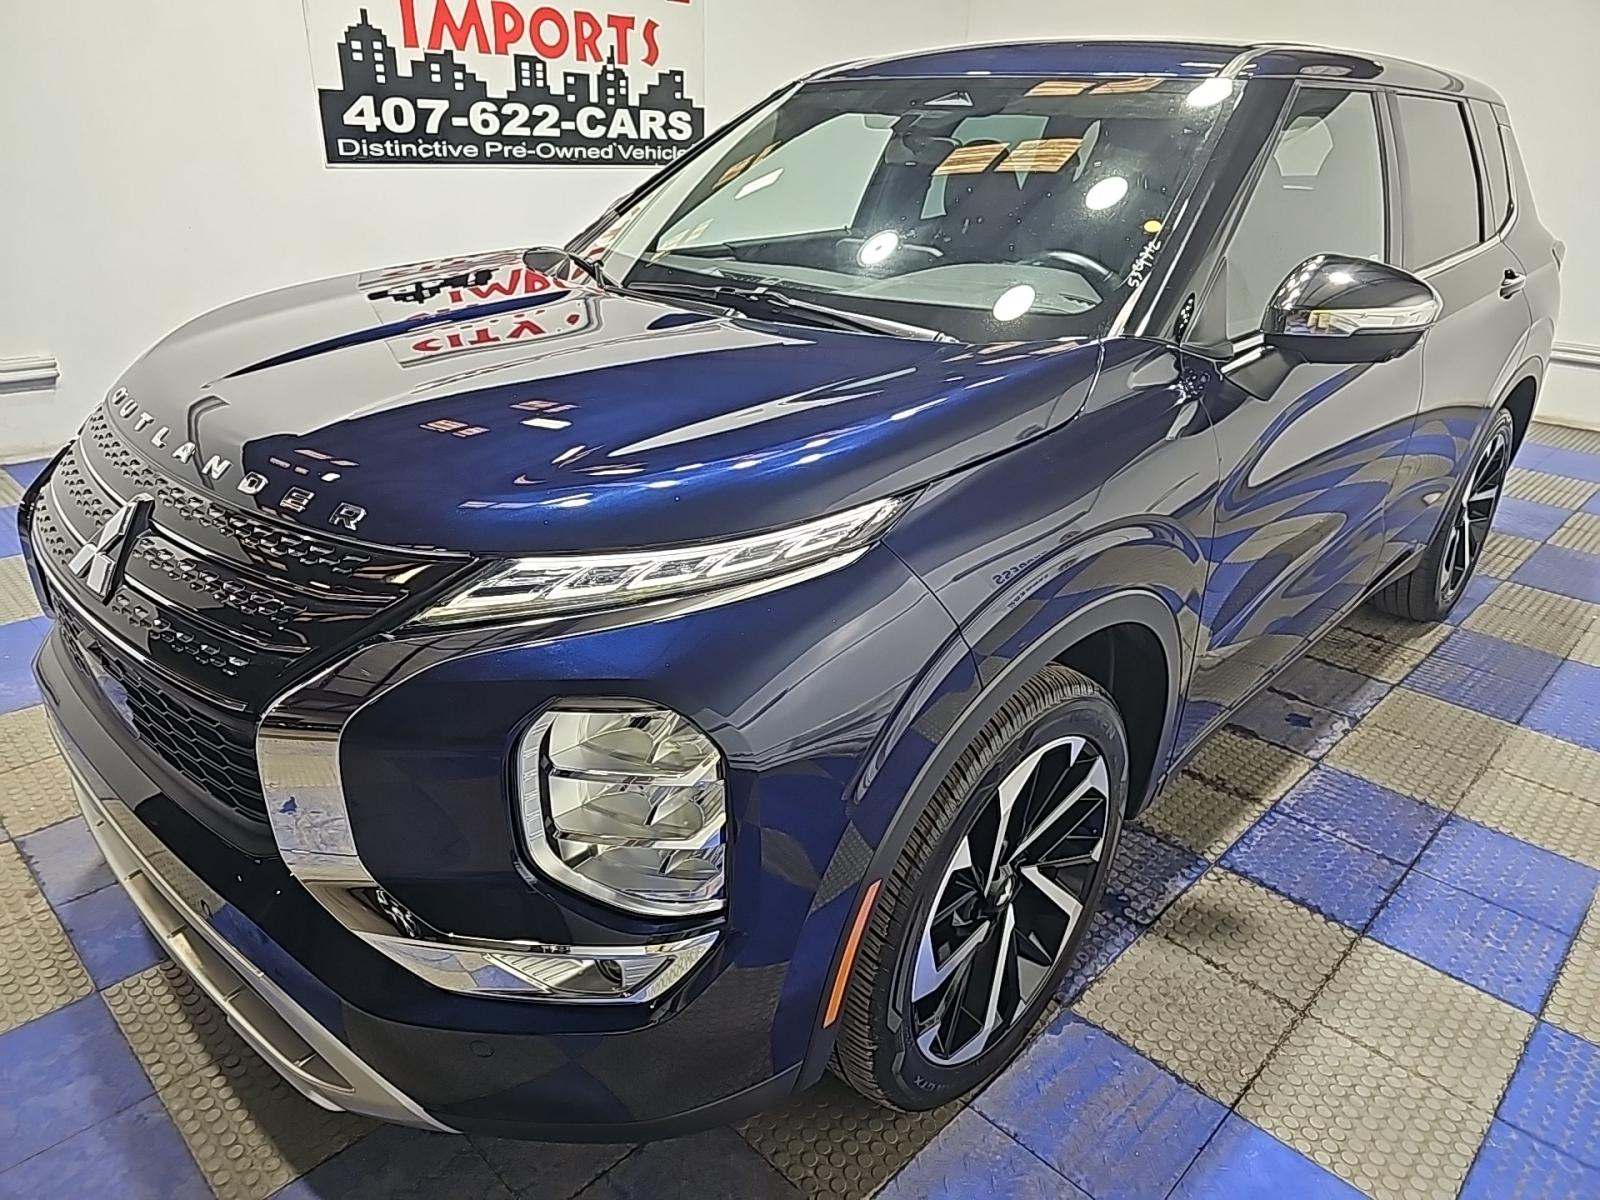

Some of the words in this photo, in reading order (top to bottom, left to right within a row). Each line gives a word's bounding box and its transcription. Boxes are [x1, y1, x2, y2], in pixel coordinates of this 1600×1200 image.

[401, 0, 660, 67] IMPORTS
[342, 95, 693, 141] 407-622-CARS
[337, 138, 479, 159] Distinctive
[485, 141, 614, 160] Pre-Owned
[616, 144, 688, 161] Vehicle
[112, 386, 368, 531] OUTLANDER
